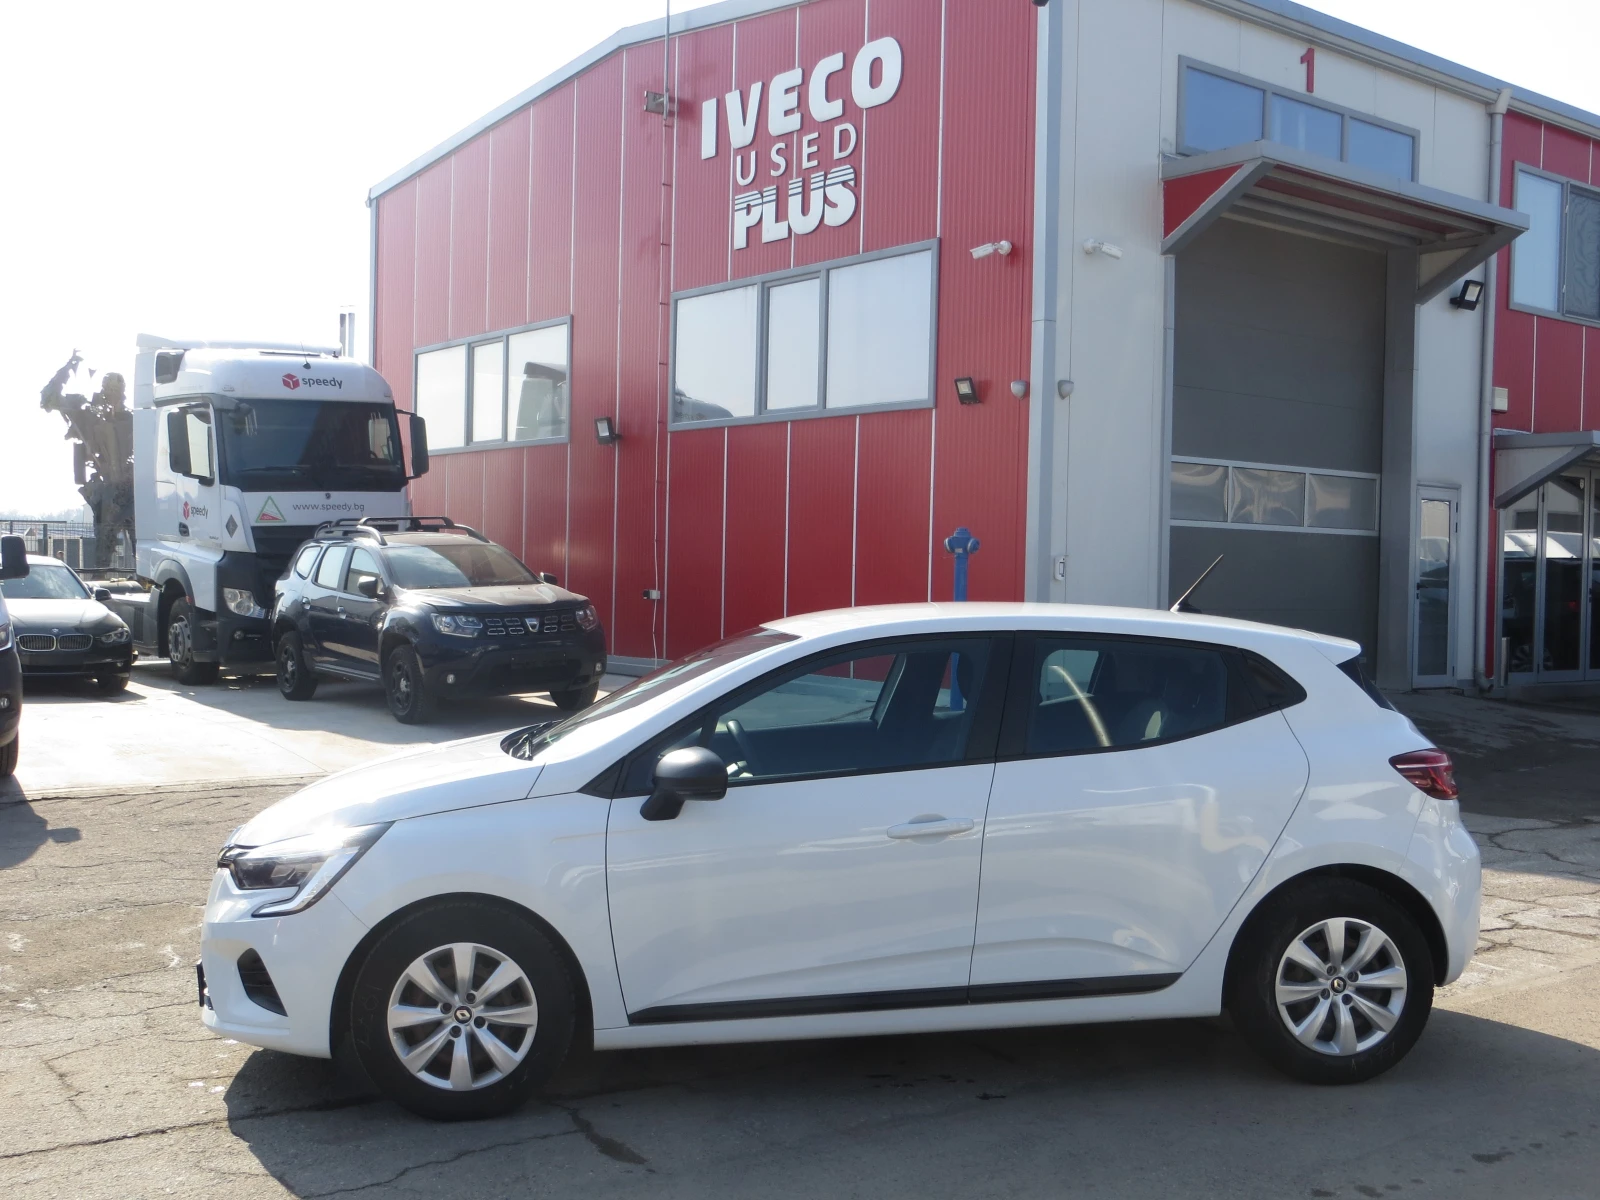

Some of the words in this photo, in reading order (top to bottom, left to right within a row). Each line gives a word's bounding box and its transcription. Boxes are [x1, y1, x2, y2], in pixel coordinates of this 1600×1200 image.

[1300, 47, 1315, 93] 1
[701, 36, 903, 160] IVECO
[736, 122, 858, 186] USED
[734, 164, 857, 250] PLUS
[301, 377, 343, 389] speedy
[190, 505, 208, 520] speedy
[292, 502, 365, 512] www.speedy.bg
